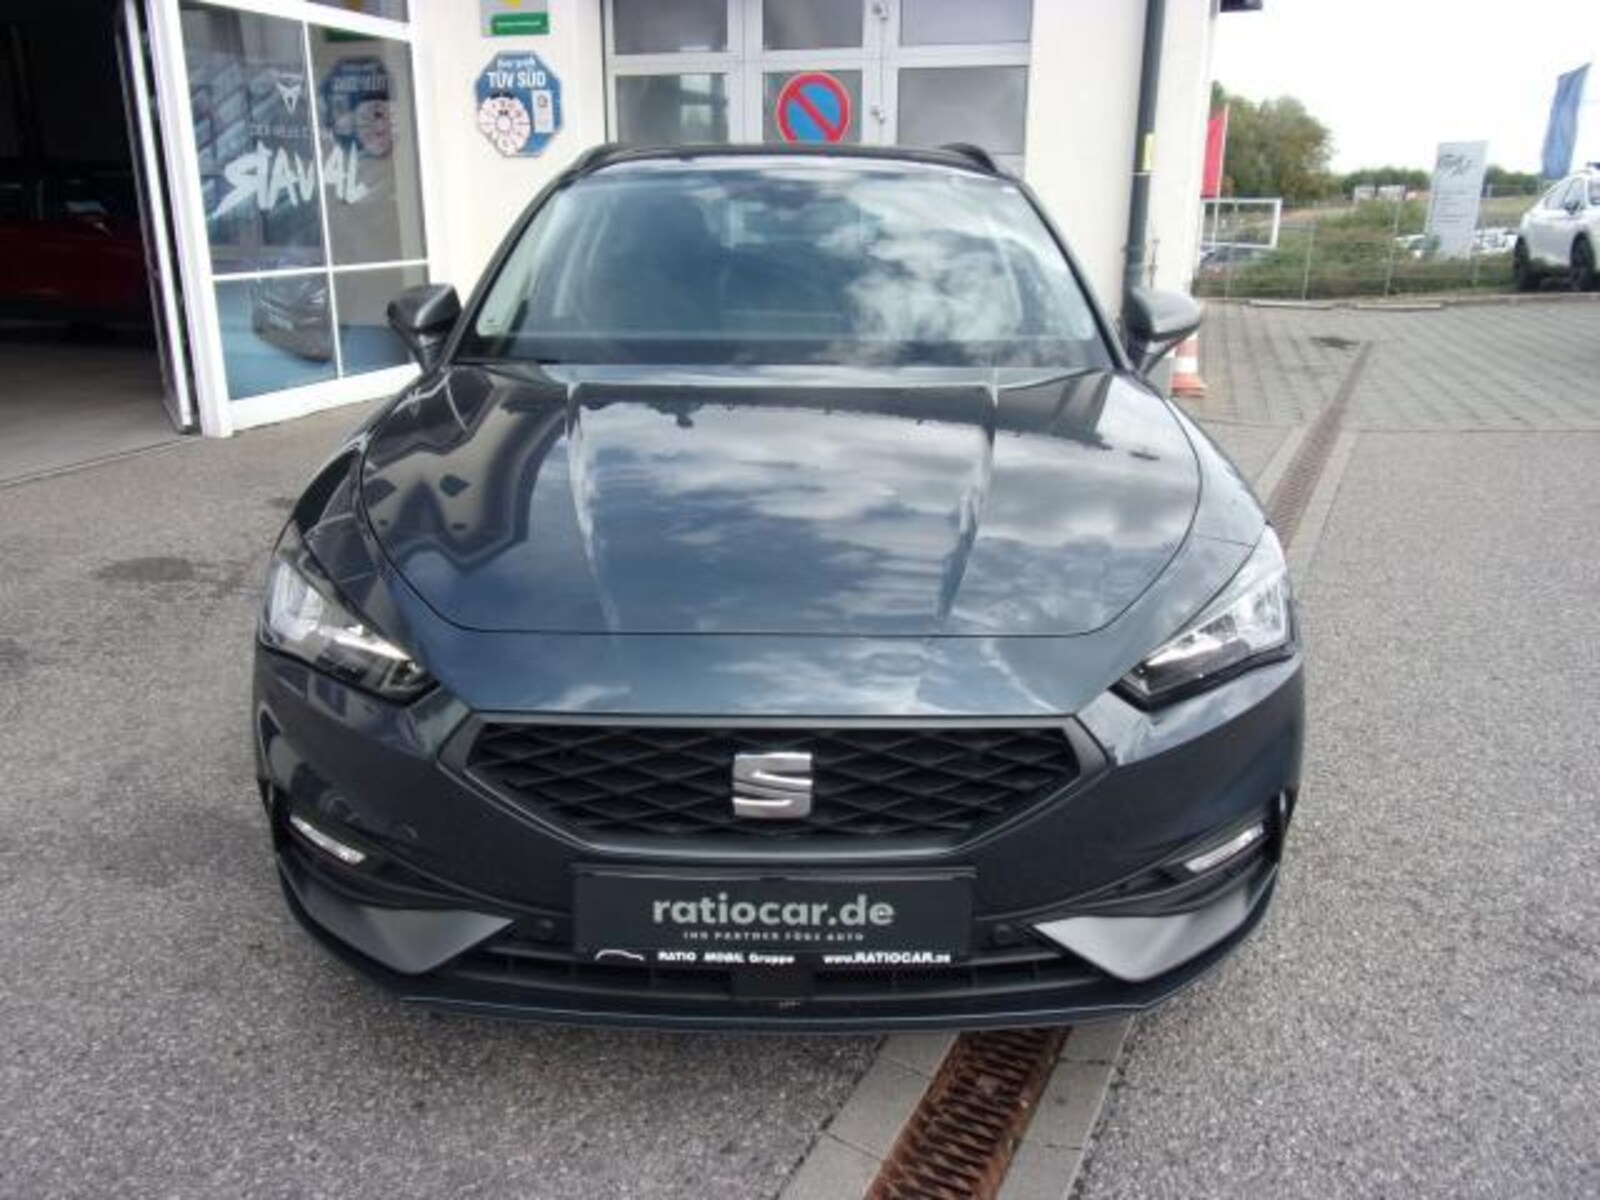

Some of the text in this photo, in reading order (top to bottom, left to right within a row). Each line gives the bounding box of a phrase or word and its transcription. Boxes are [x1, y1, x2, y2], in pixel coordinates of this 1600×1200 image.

[486, 68, 546, 88] TÜV SÜD
[653, 892, 895, 926] ratiocar.de
[714, 931, 779, 940] PARTNER
[658, 951, 697, 961] RATIO
